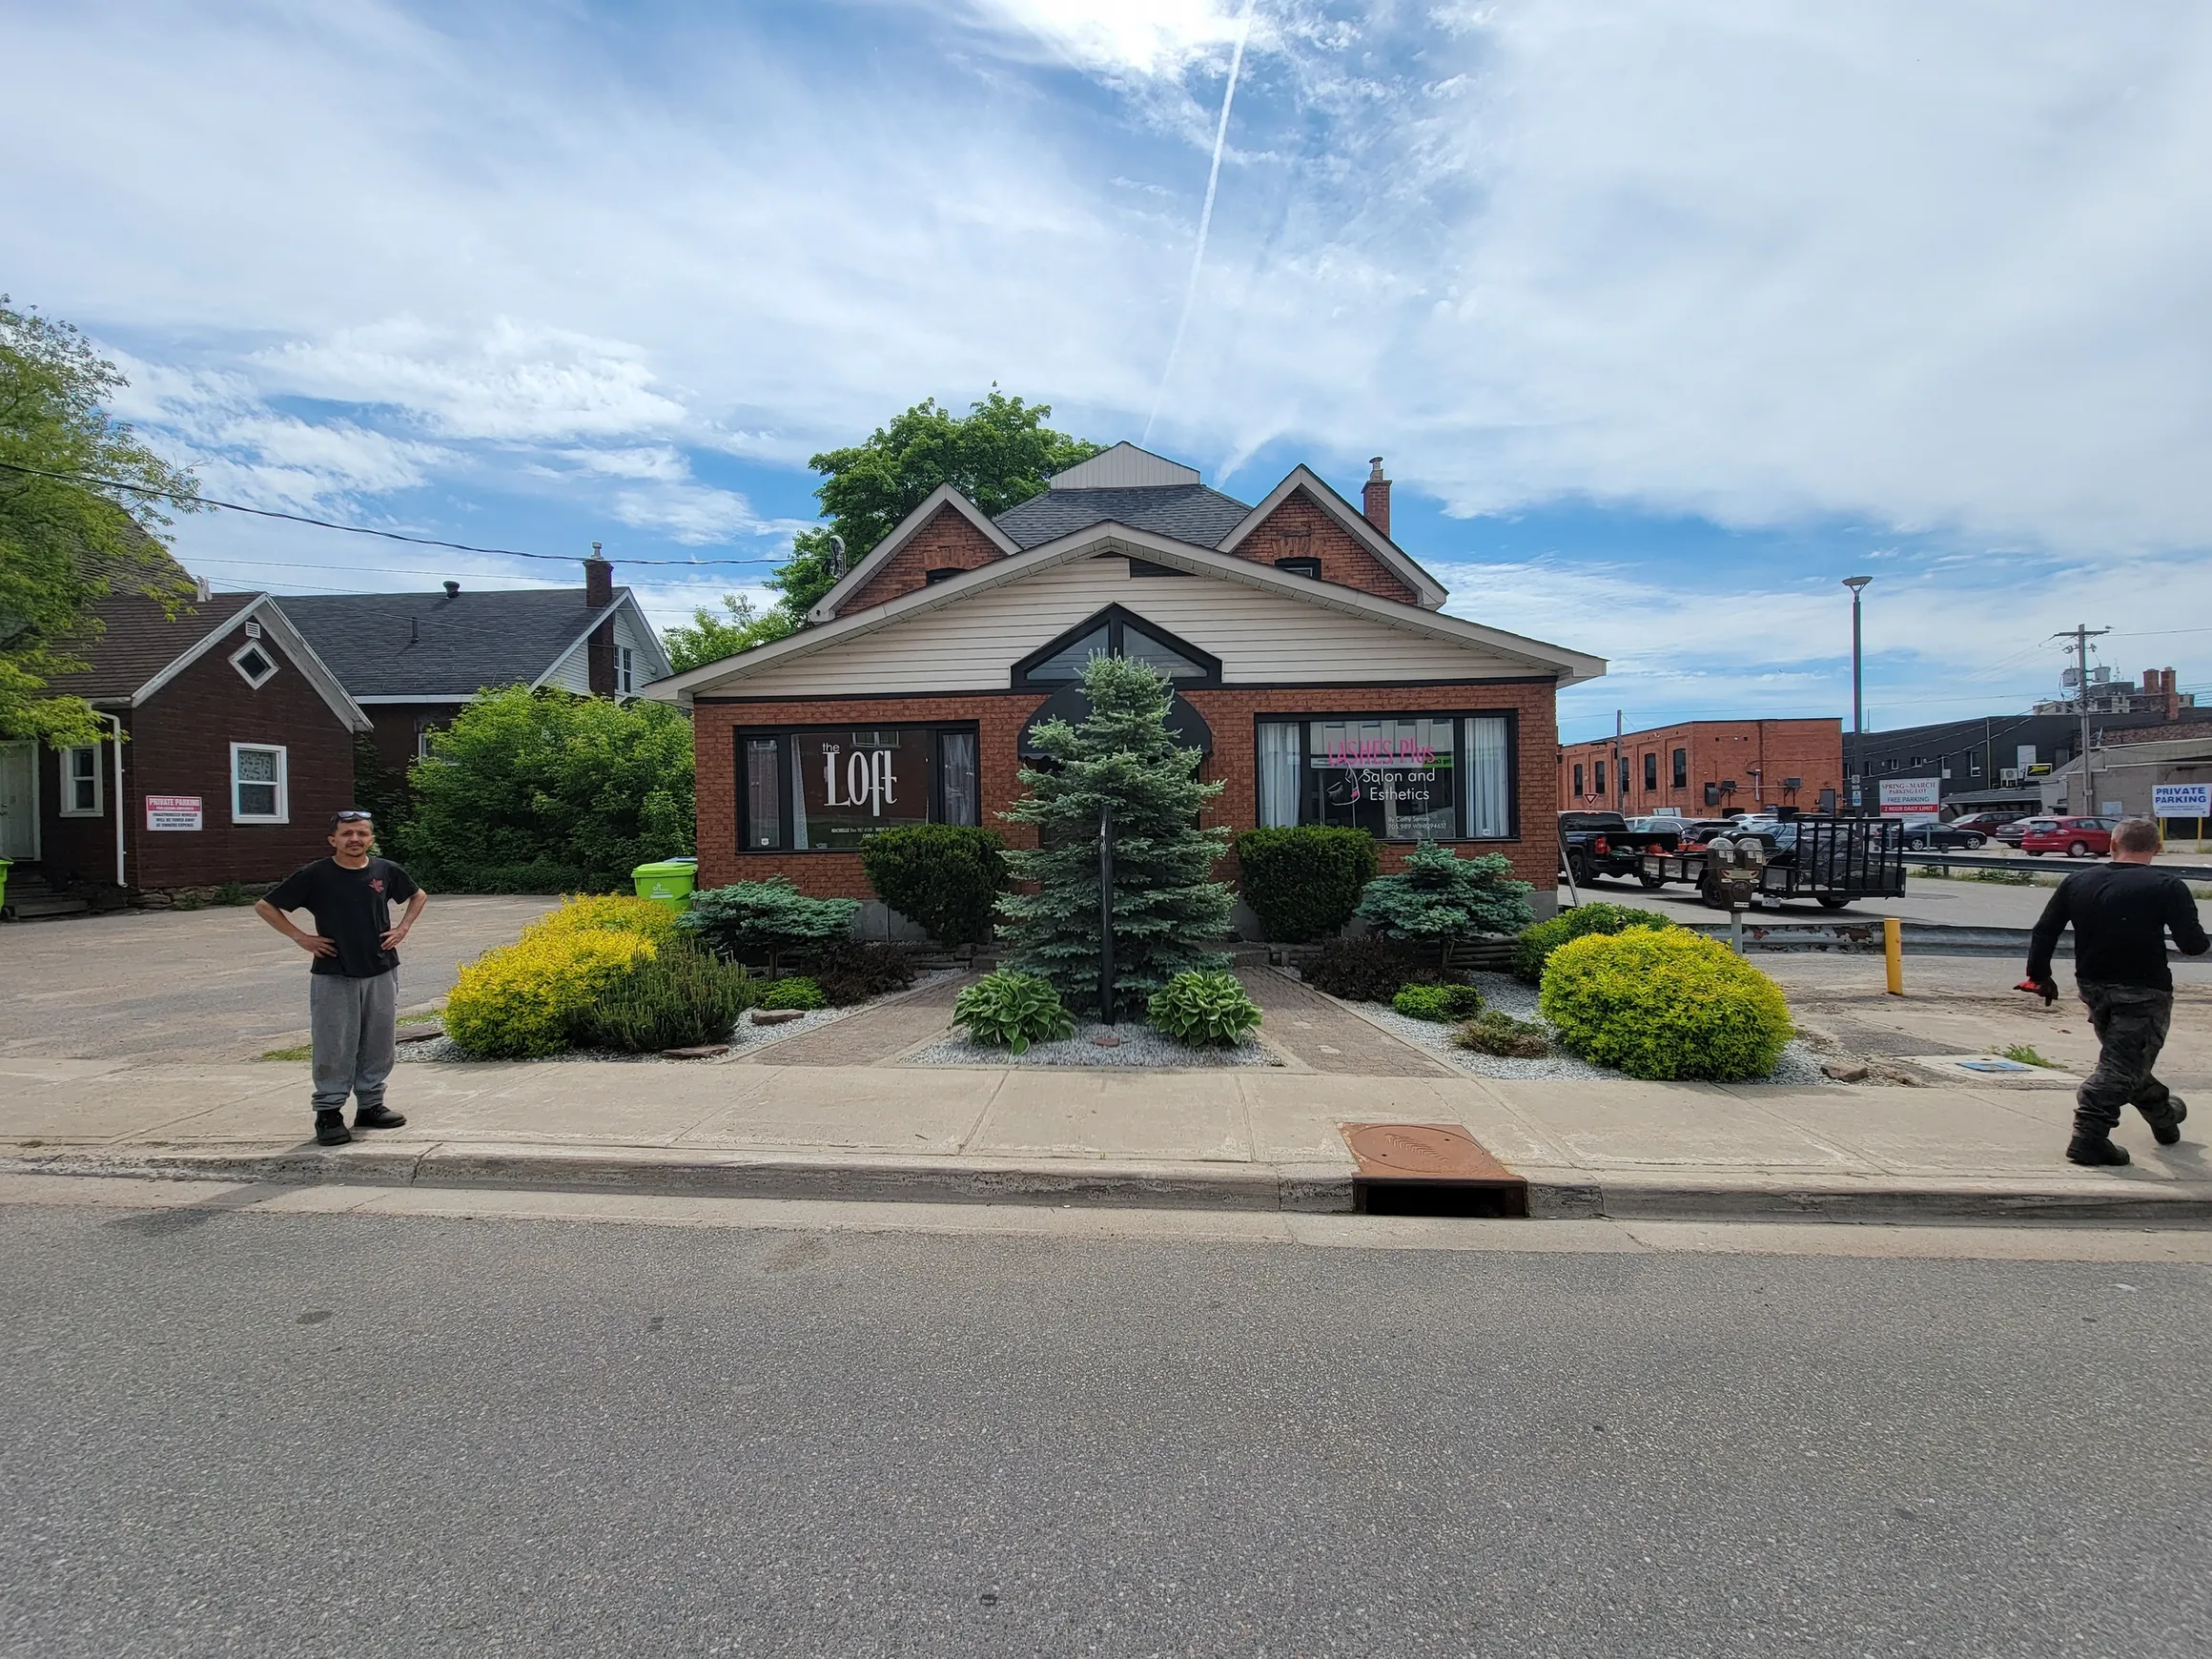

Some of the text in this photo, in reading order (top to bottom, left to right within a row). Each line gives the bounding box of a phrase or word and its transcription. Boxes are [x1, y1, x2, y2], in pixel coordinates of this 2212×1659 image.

[823, 743, 840, 751] the
[1327, 738, 1435, 766] LASHES Plus
[1362, 768, 1435, 783] Salon and
[1370, 788, 1429, 800] Esthetics
[2156, 787, 2205, 795] PRIVATE
